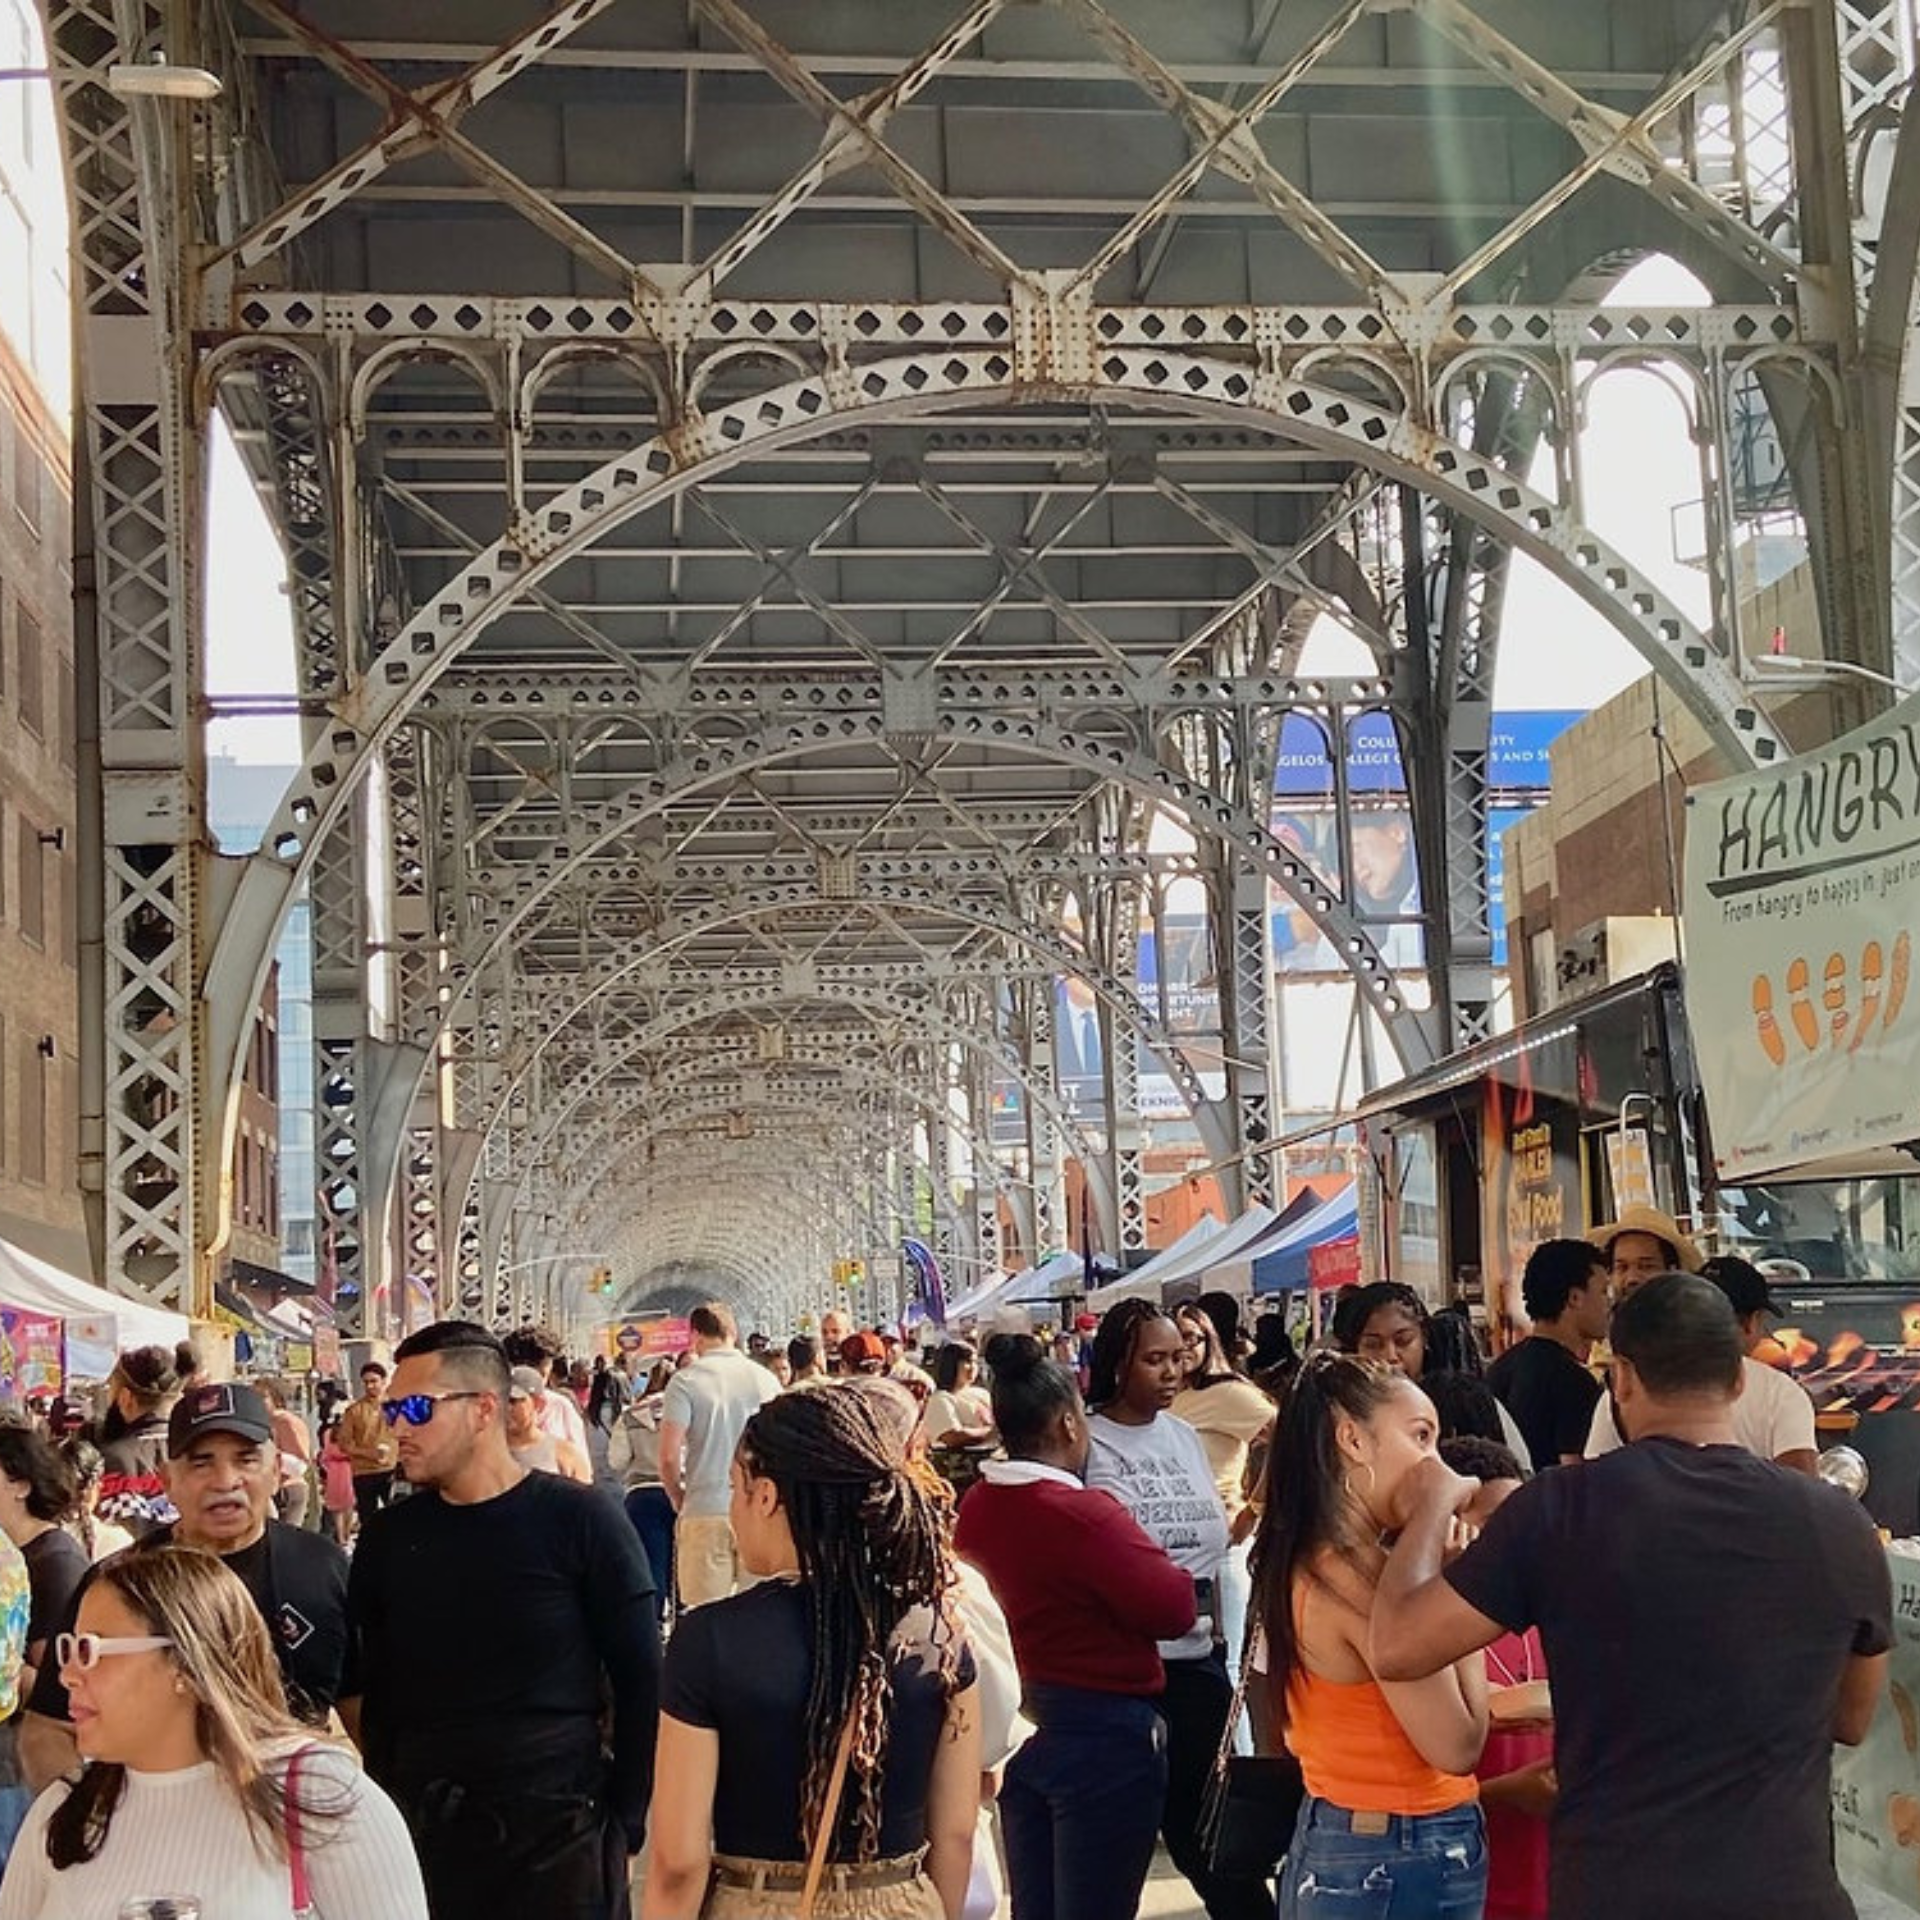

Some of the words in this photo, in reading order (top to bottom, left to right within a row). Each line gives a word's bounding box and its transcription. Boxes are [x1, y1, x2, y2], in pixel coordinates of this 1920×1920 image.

[1722, 900, 1753, 923] From
[1756, 894, 1801, 919] hangry
[1822, 879, 1860, 906] happy
